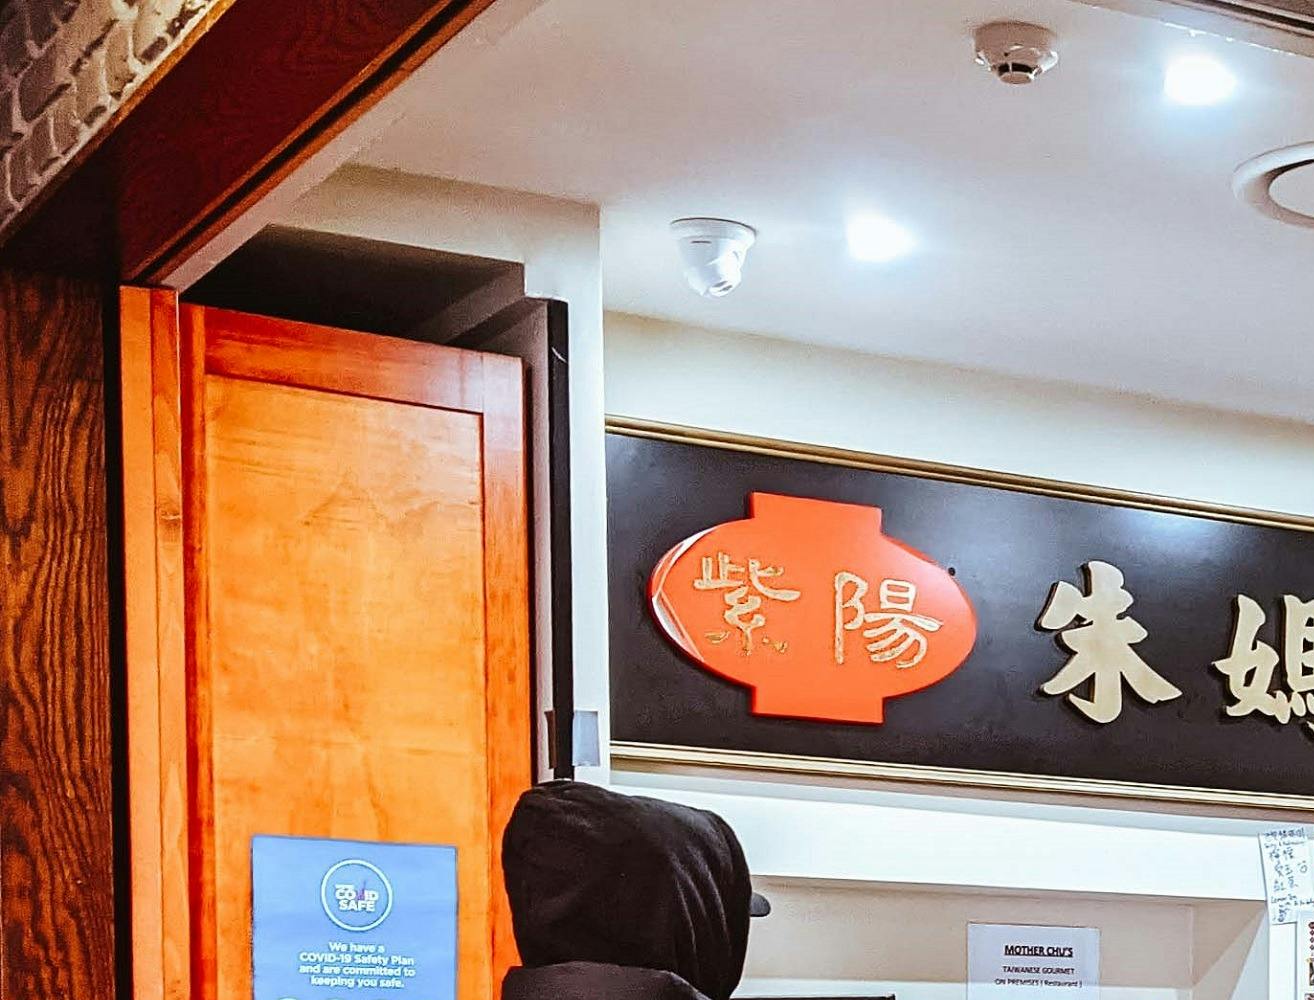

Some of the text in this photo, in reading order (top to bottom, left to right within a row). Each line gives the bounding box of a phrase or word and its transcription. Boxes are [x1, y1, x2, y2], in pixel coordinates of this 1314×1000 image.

[693, 551, 944, 669] 紫陽
[339, 900, 375, 912] SAFE
[329, 942, 385, 953] We have a
[1004, 945, 1073, 958] MOTHER CHU'S
[299, 952, 415, 966] COVID-19 Safety Plan
[299, 963, 416, 976] and are committed to
[1003, 965, 1075, 975] TAIWANESE GOURMET
[311, 975, 405, 989] keeping you safe.
[1007, 979, 1039, 987] PREMISES
